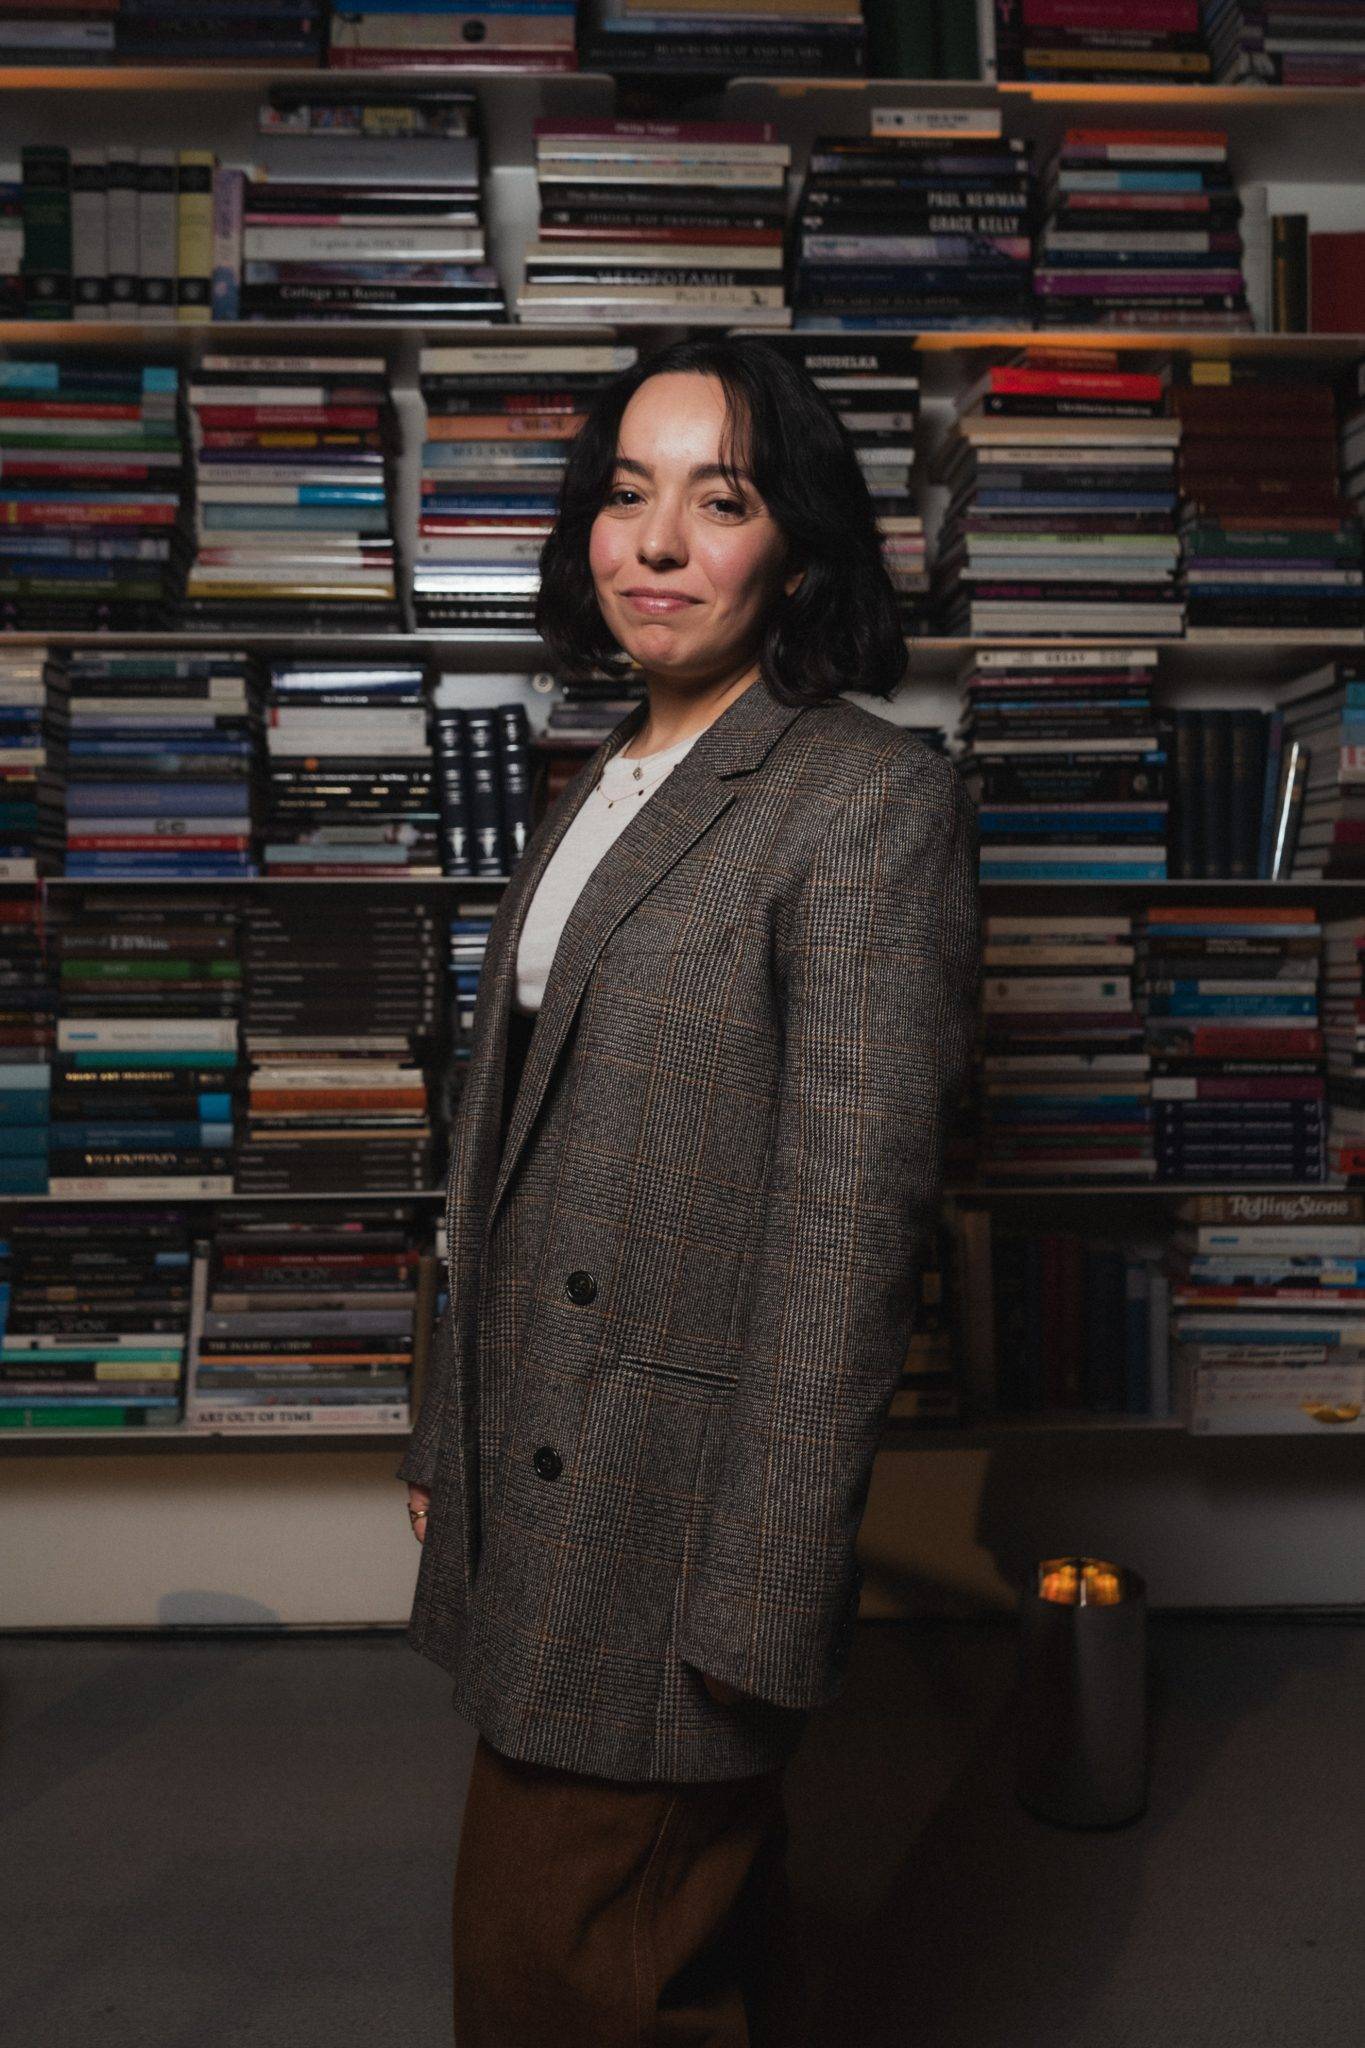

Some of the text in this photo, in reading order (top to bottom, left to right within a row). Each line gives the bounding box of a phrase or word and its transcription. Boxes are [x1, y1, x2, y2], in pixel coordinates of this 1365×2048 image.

[926, 191, 1028, 208] PAUL NEWMAN
[928, 214, 1020, 232] GRACE KELLY
[200, 1412, 312, 1422] ART OUT OF TIME
